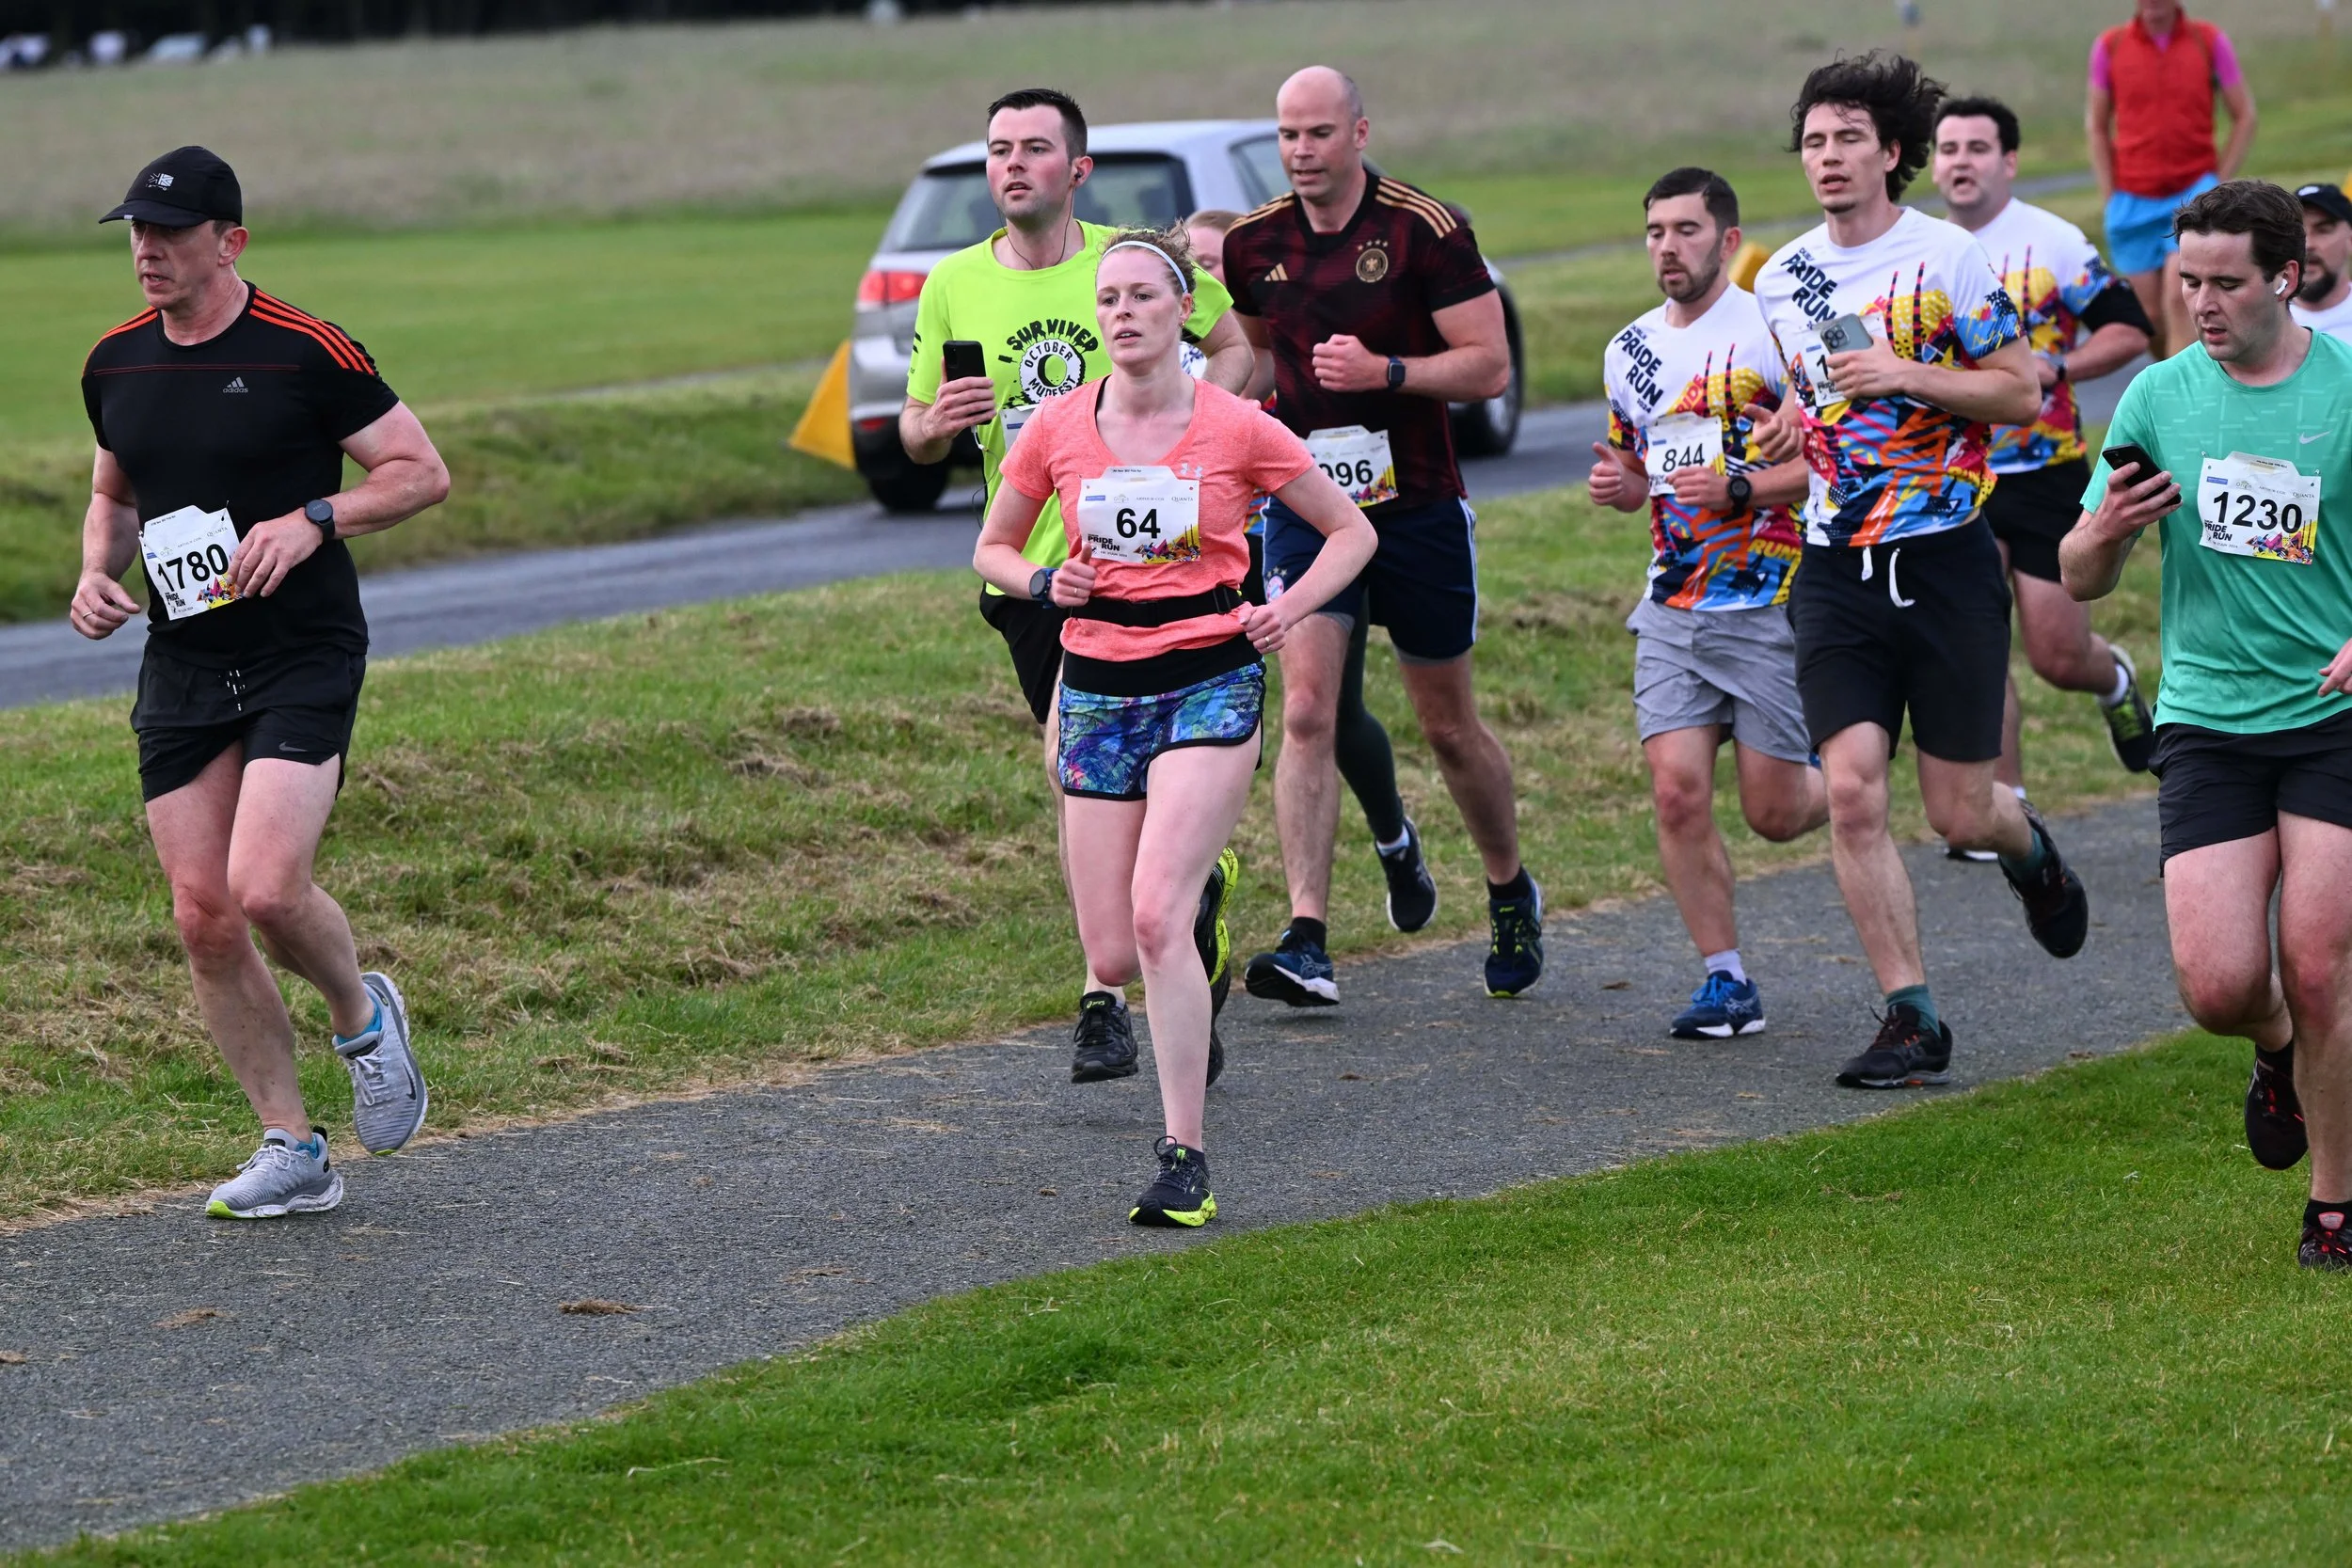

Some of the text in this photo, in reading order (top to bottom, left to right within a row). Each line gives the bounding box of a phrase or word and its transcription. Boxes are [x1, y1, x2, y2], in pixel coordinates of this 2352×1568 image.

[1780, 253, 1838, 300] PRIDE
[1791, 286, 1837, 324] RUN
[997, 318, 1099, 363] I SURVIVED
[1025, 341, 1073, 369] OCTOBER
[1614, 329, 1663, 378] PRIDE
[1028, 374, 1076, 398] MUDFEST
[1626, 363, 1664, 409] RUN
[1661, 442, 1706, 472] 844
[1116, 508, 1161, 539] 64
[2204, 522, 2227, 533] PRIDE
[2214, 491, 2302, 534] 1230
[1088, 535, 1113, 544] PRIDE
[1102, 543, 1120, 552] RUN
[2213, 531, 2233, 542] RUN
[158, 544, 229, 592] 1780
